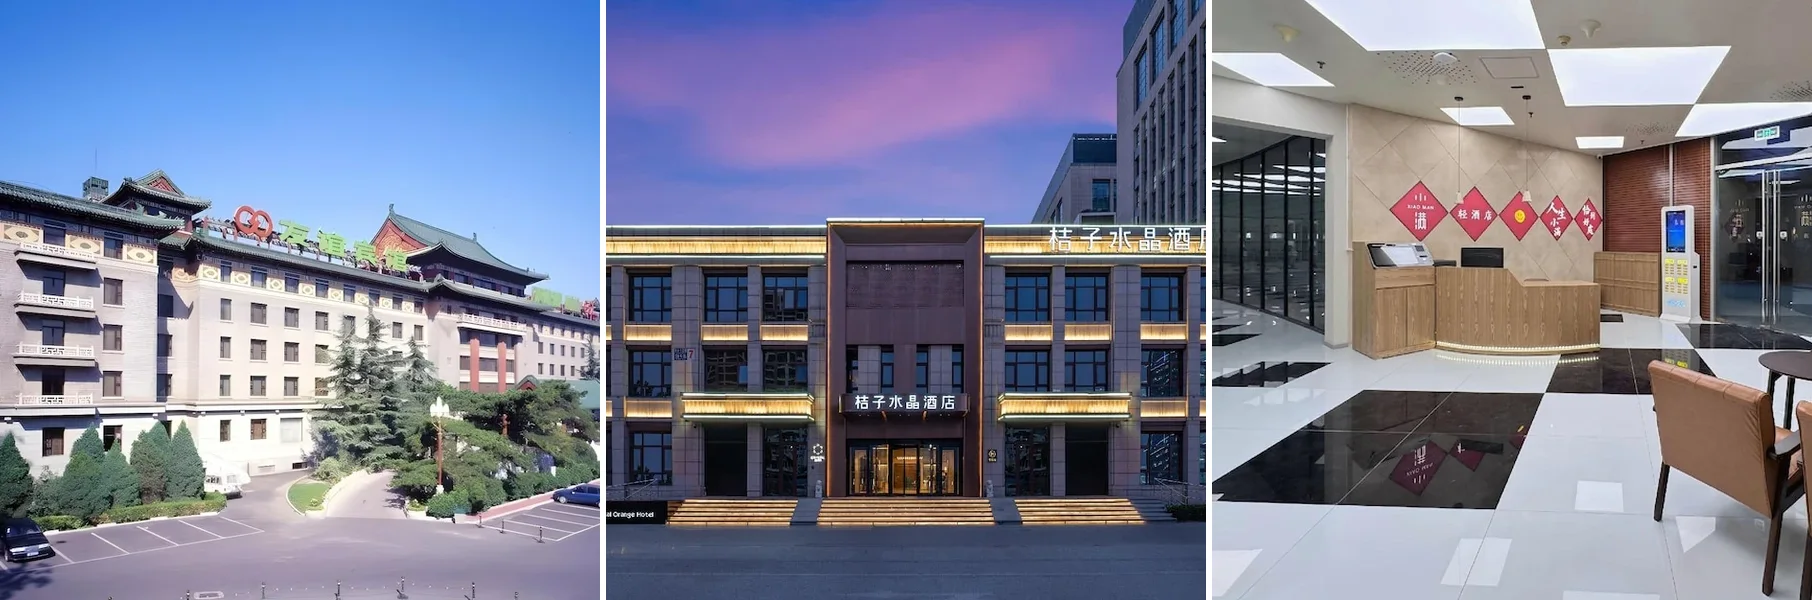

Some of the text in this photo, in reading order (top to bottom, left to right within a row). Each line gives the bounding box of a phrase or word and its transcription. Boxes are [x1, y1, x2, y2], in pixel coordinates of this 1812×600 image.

[1458, 209, 1492, 221] 轻酒店
[1049, 226, 1206, 251] 桔子水晶酒
[688, 349, 694, 359] 7
[854, 394, 956, 410] 桔子水晶酒店
[612, 511, 635, 519] Orange
